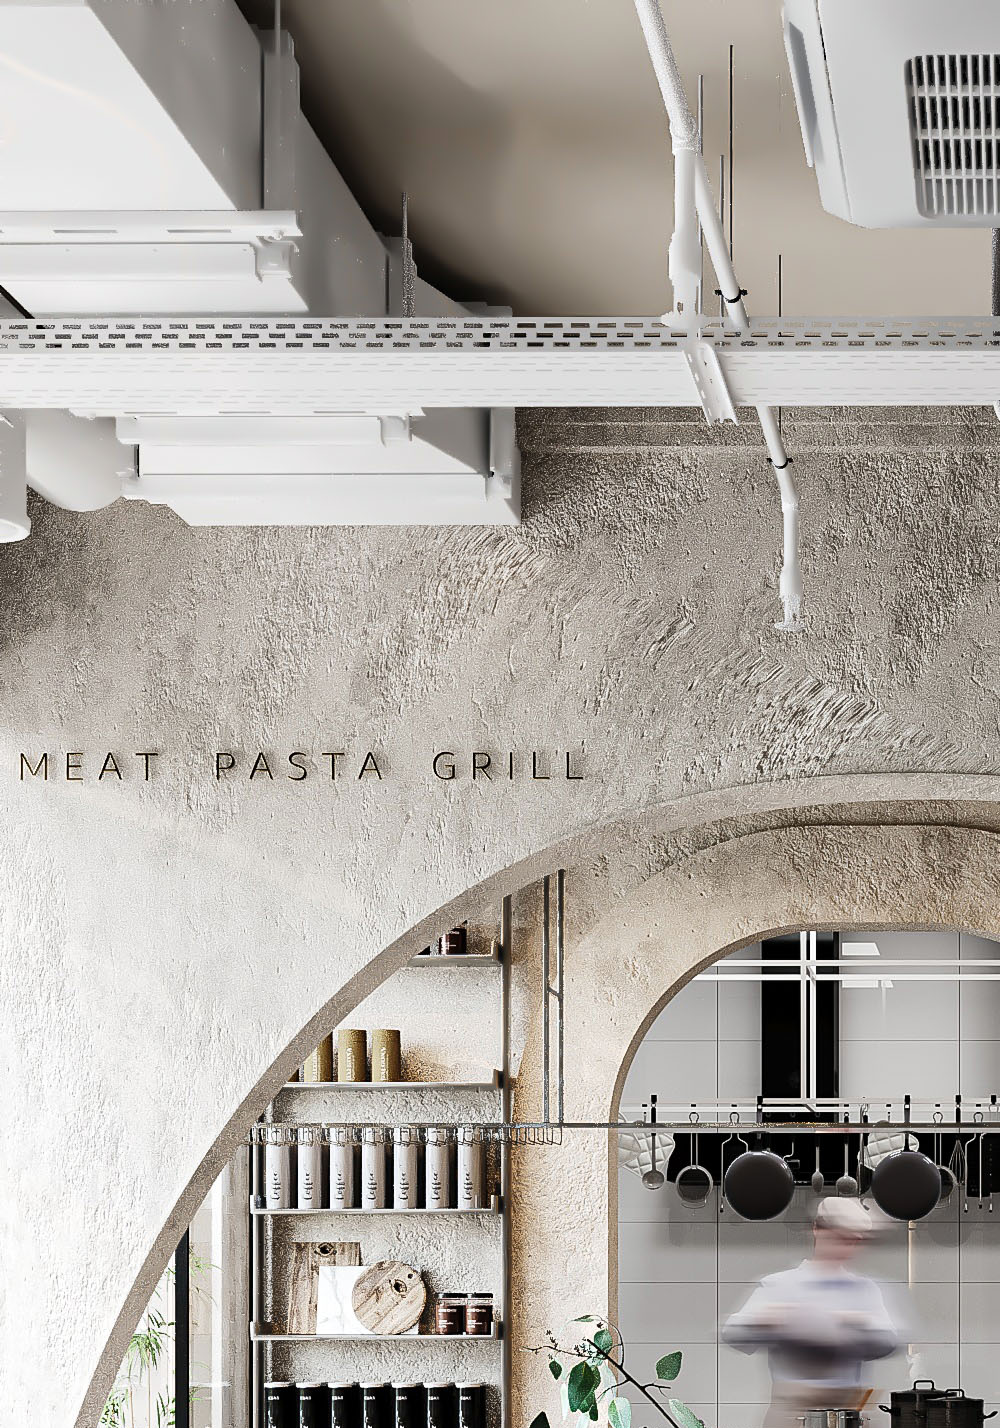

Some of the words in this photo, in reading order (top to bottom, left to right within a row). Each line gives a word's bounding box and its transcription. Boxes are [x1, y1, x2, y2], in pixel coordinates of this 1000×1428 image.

[19, 752, 159, 781] MEAT
[215, 752, 383, 781] PASTA
[432, 751, 584, 781] GRILL
